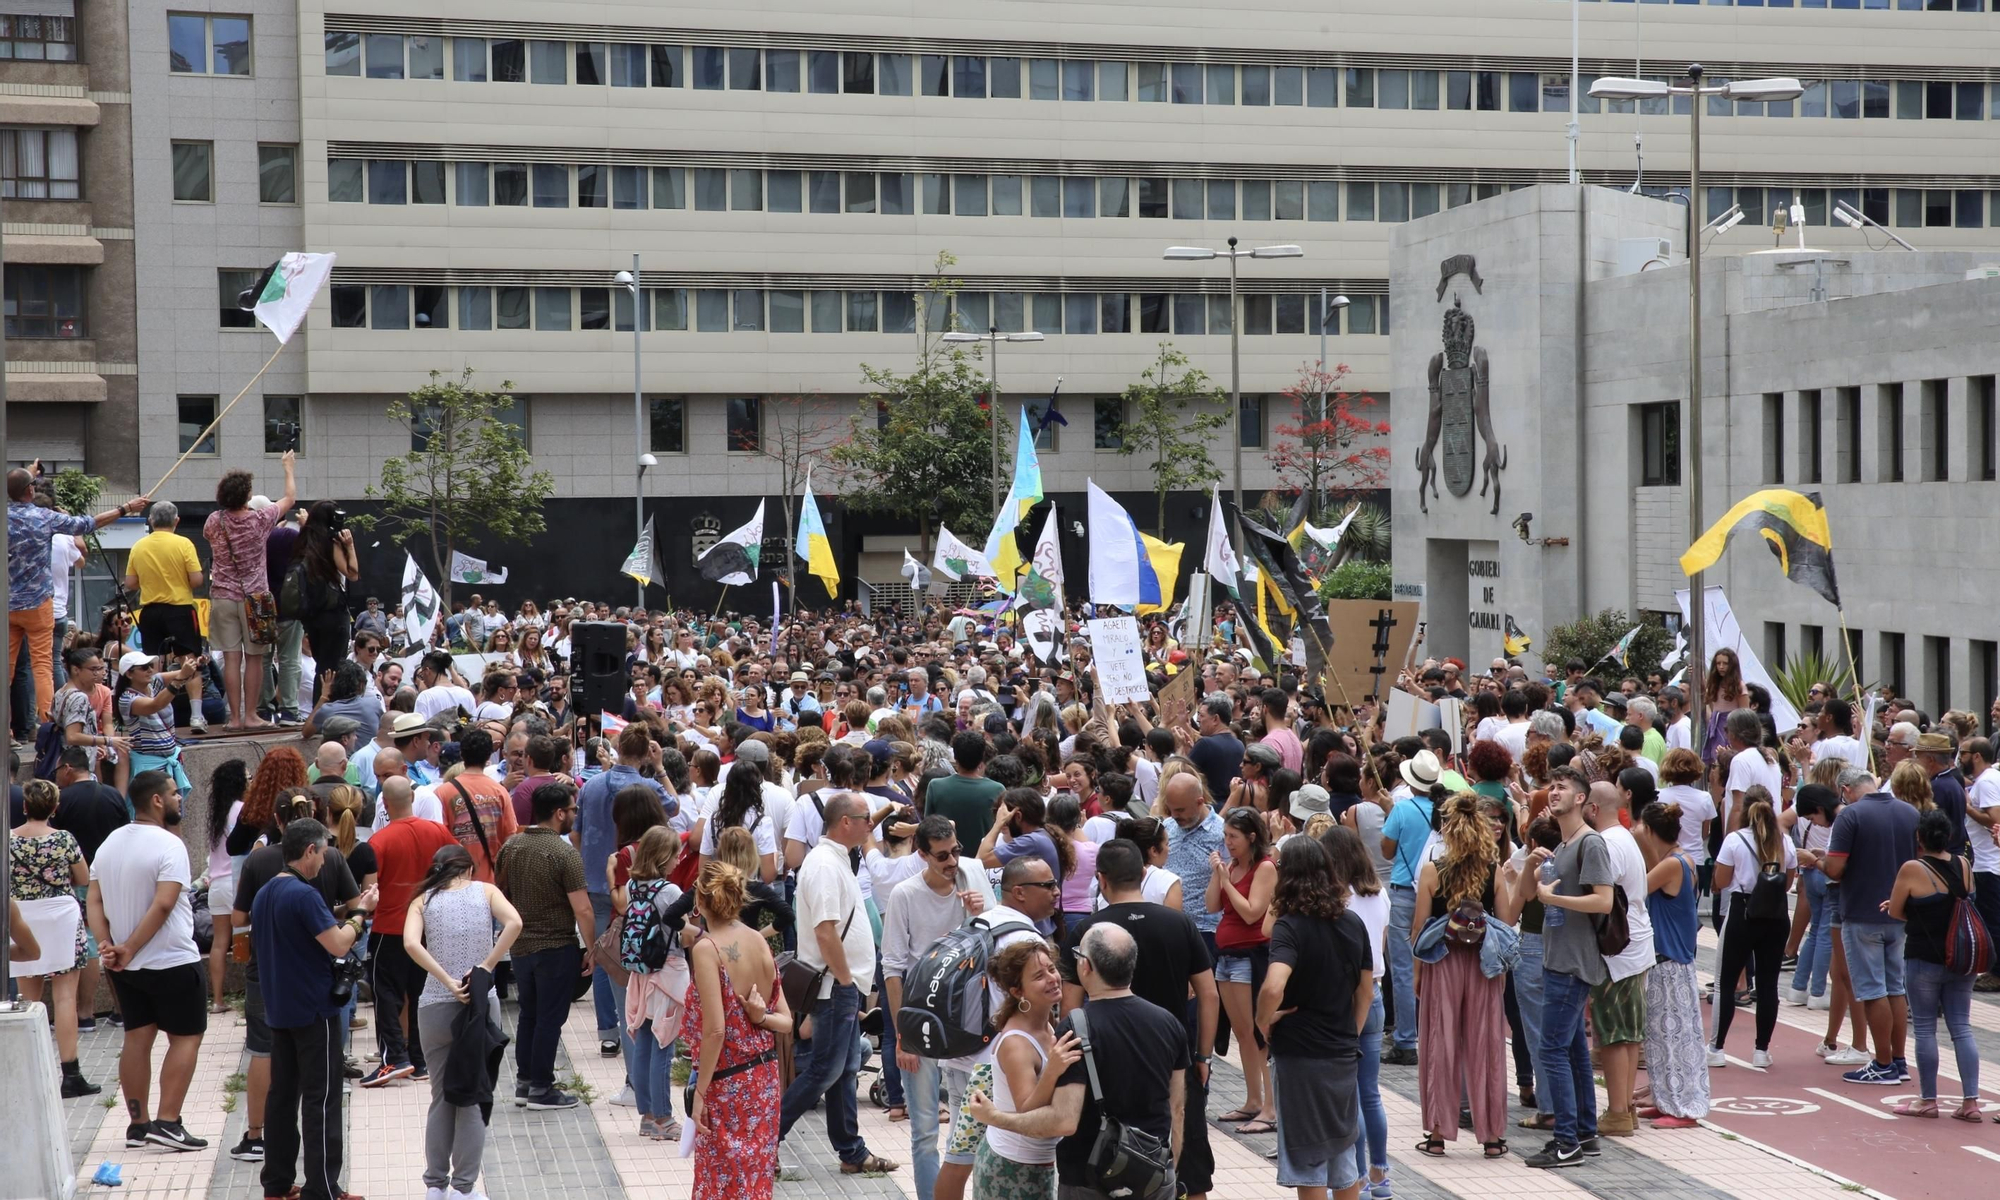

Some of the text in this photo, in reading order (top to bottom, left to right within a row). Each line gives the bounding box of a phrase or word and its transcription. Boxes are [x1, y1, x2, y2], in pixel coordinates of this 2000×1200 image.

[1483, 586, 1494, 604] DE
[1103, 619, 1128, 630] AGAETE
[1103, 634, 1129, 644] MIRALO
[1112, 648, 1116, 657] Y
[1110, 662, 1127, 671] VETE
[1123, 672, 1133, 682] NO
[1114, 684, 1148, 697] DESTROCES
[128, 1098, 141, 1119] 9
